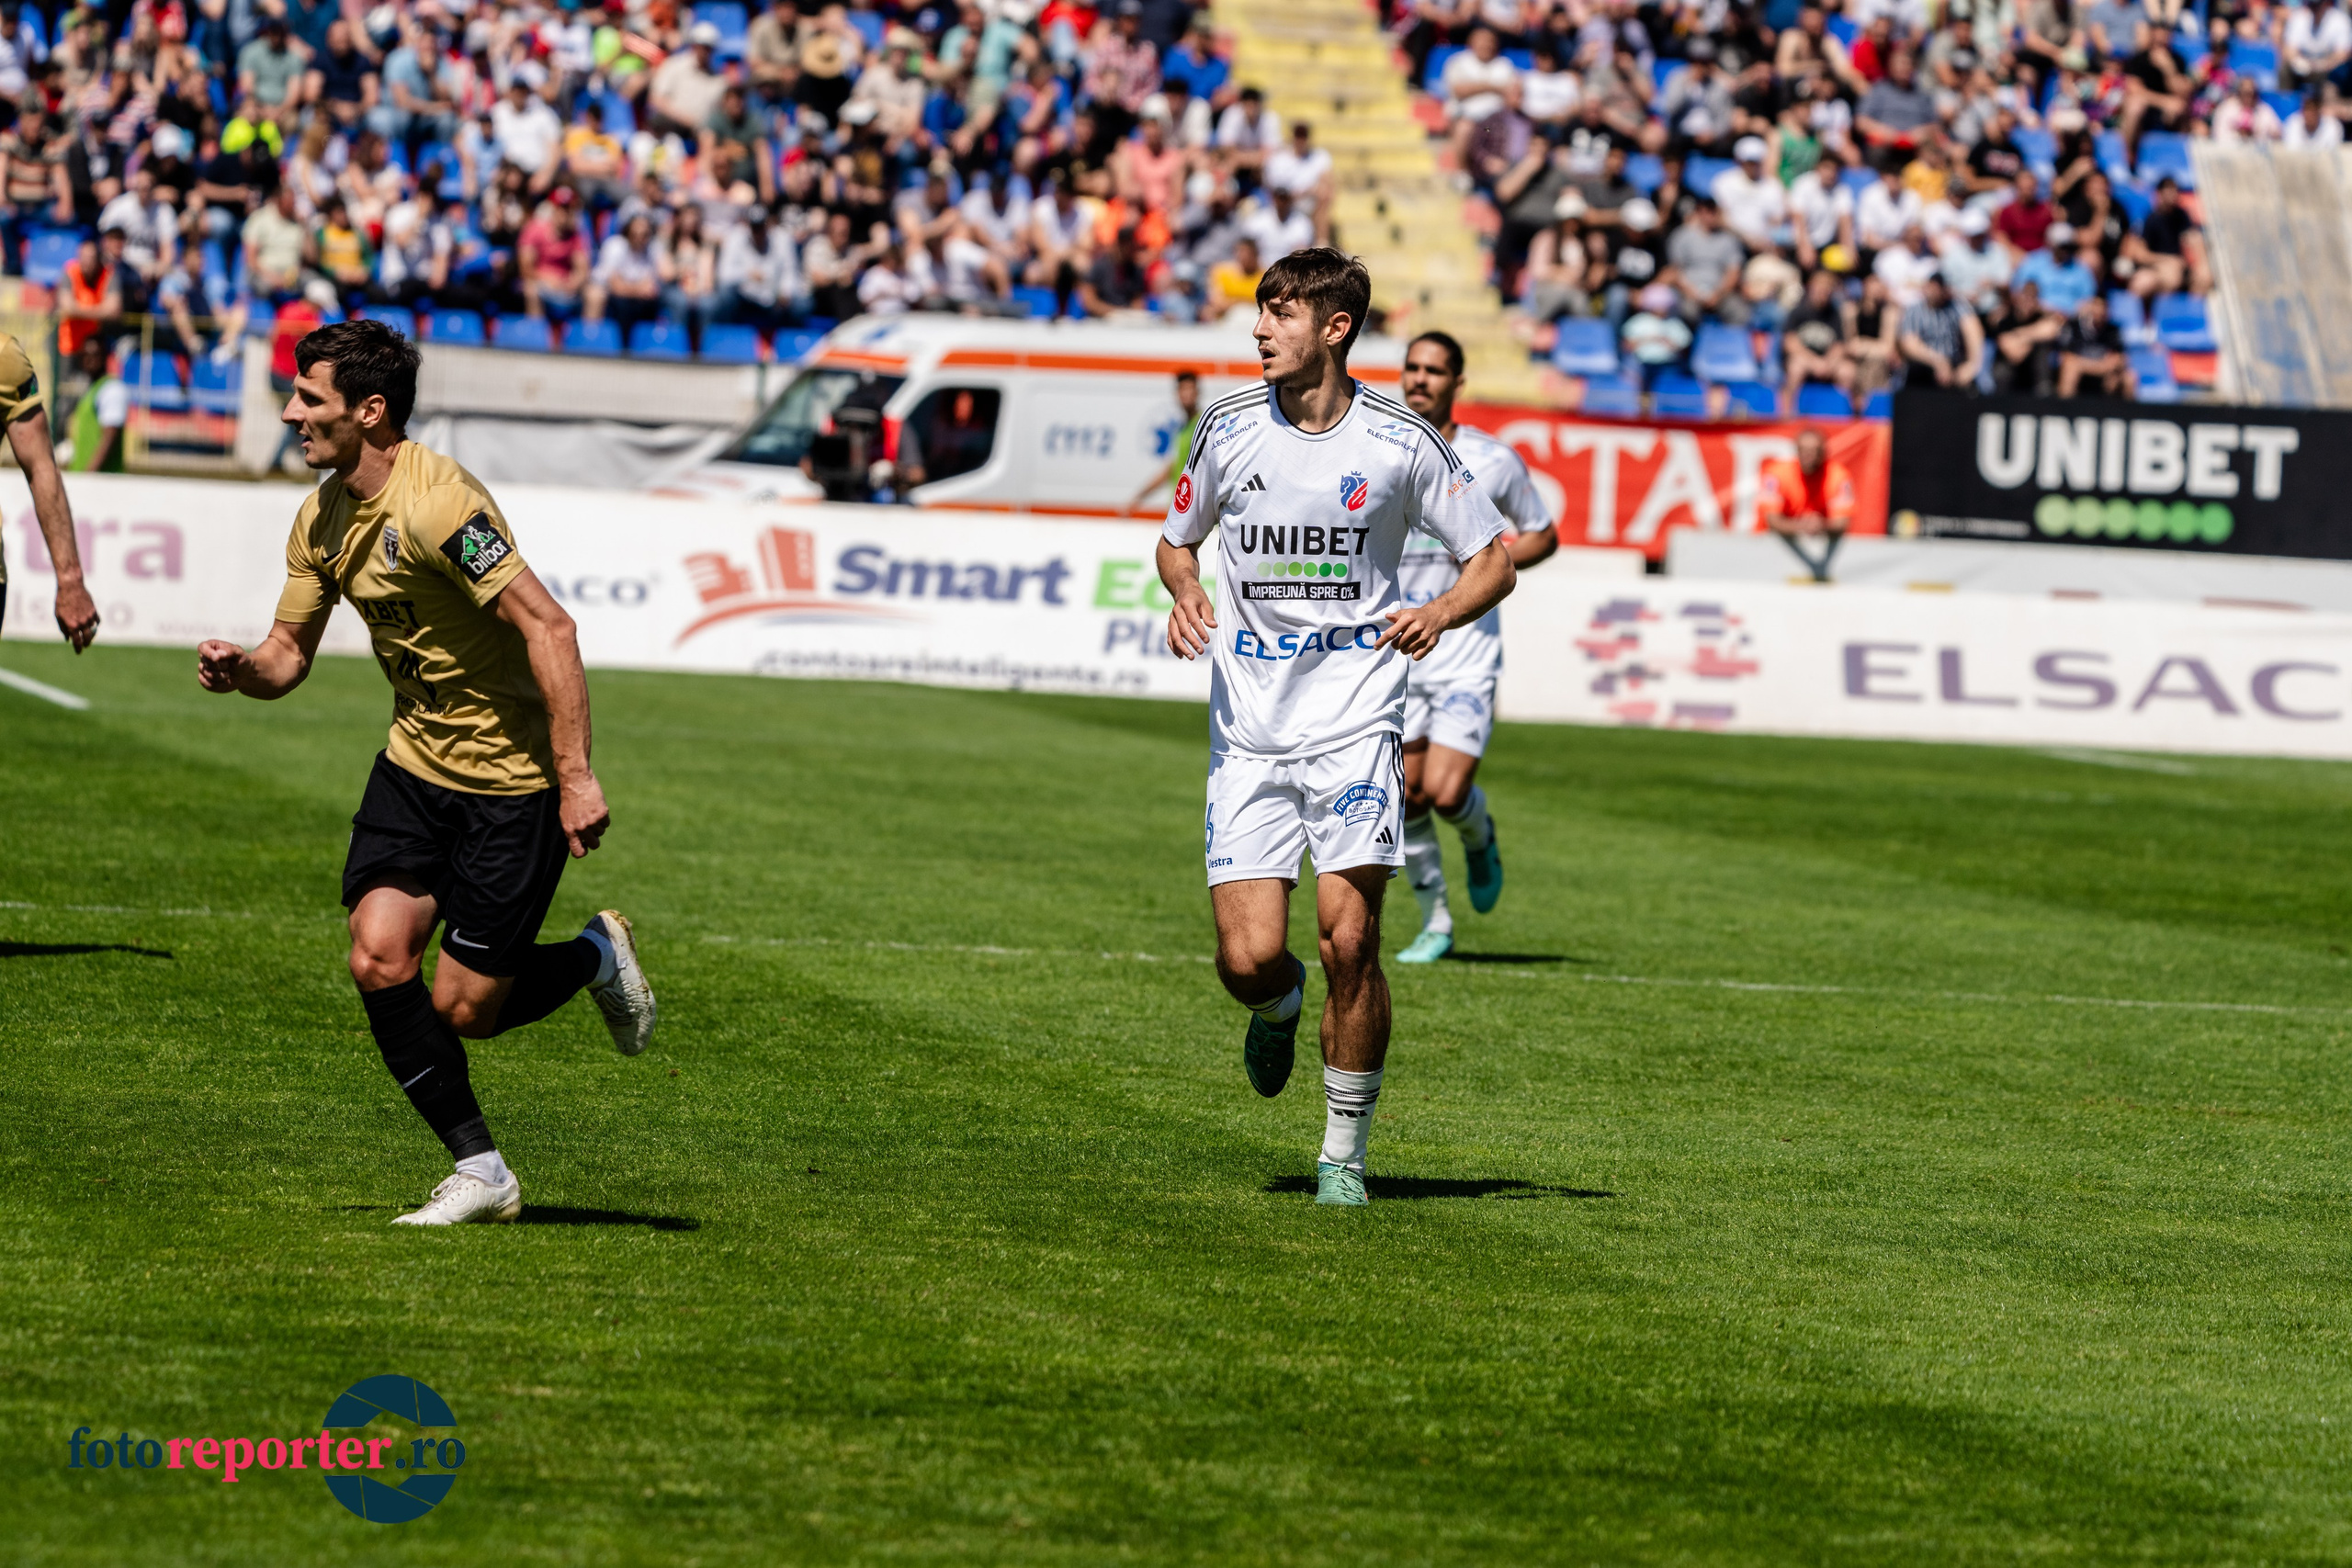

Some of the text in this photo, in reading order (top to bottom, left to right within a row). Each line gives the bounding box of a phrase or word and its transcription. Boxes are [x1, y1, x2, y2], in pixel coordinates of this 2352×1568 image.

[1211, 421, 1259, 450] LECTROALFA
[1976, 412, 2300, 501] UNIBET
[467, 540, 507, 575] bilbor
[1240, 524, 1370, 556] UNIBET
[832, 543, 1071, 607] Smart
[1248, 582, 1354, 600] ÎMPREUNĂ SPRE 0%
[1234, 624, 1382, 660] ELSACO
[1842, 641, 2352, 722] ELSAC
[1336, 796, 1350, 812] FIVE
